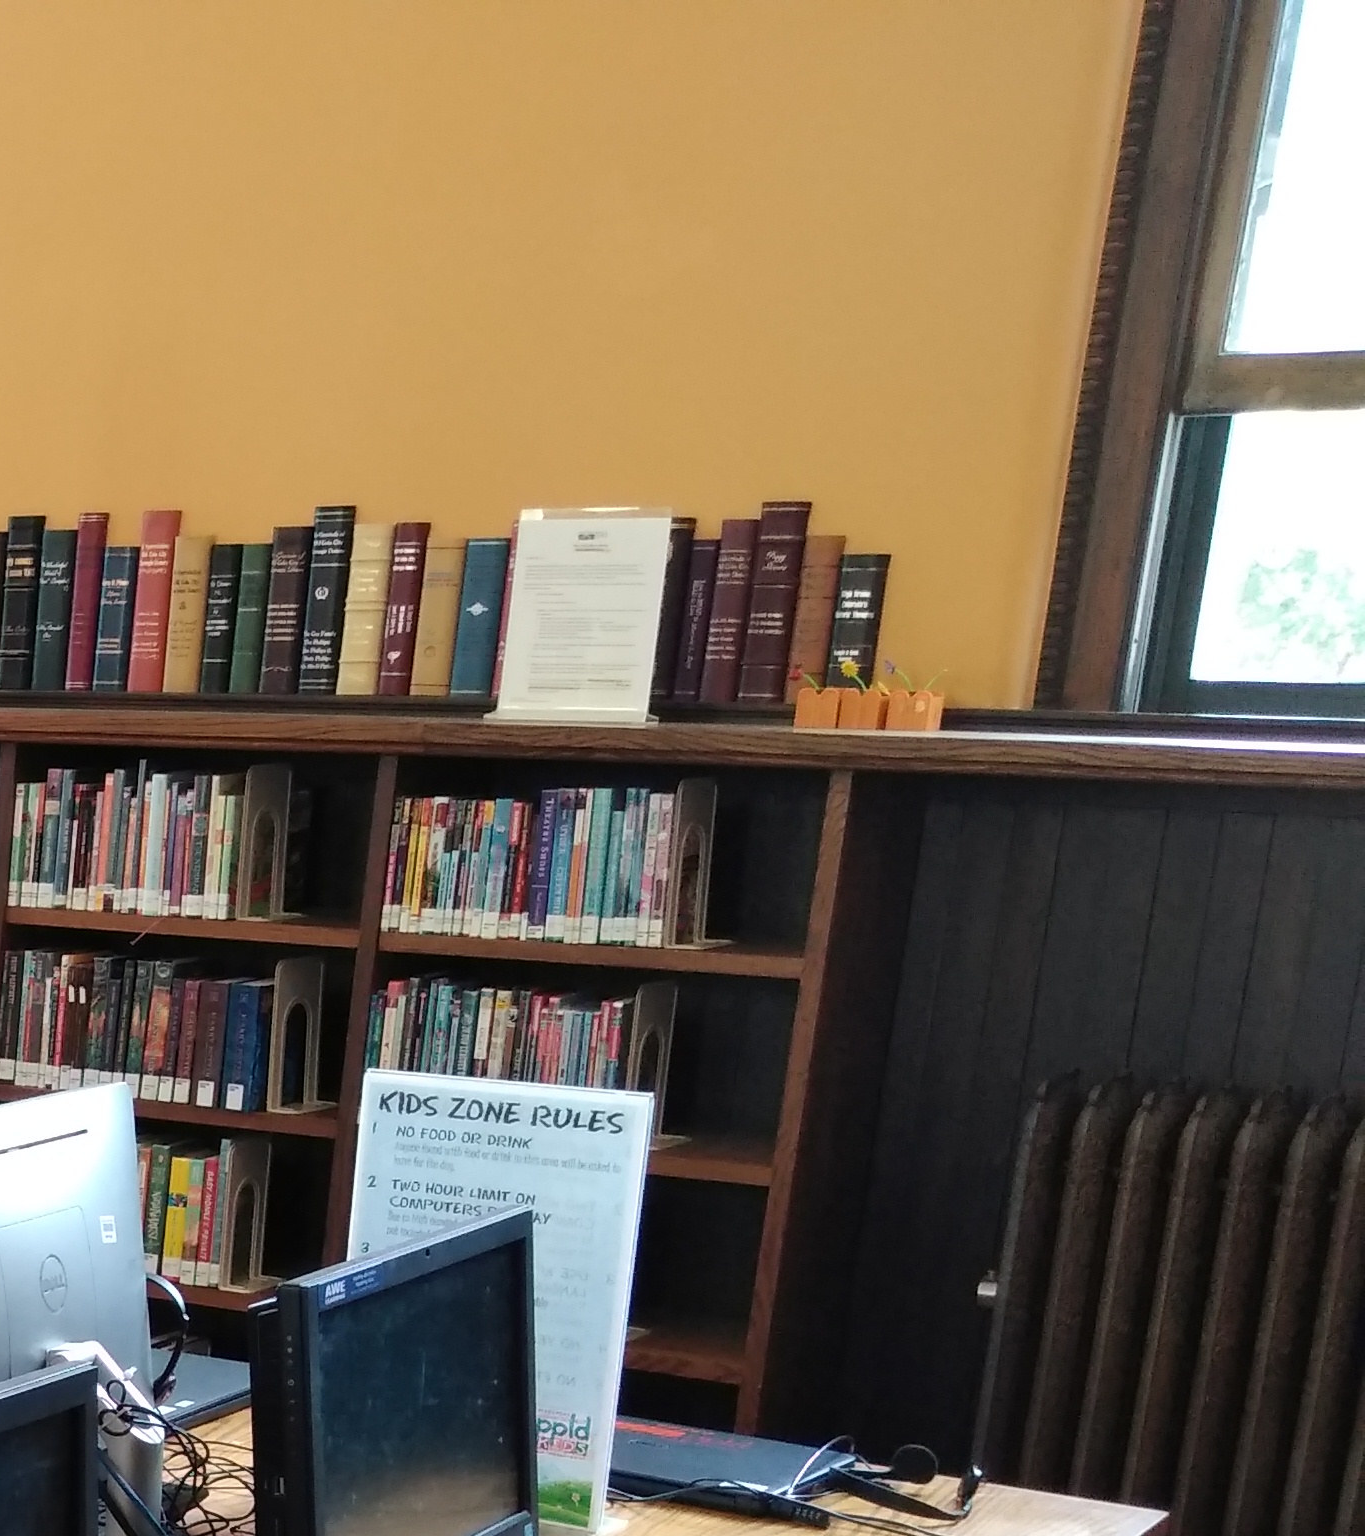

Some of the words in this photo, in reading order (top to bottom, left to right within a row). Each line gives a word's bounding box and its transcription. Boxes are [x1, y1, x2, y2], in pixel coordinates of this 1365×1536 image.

[378, 1090, 439, 1117] KIDS
[447, 1097, 521, 1125] ZONE
[530, 1104, 625, 1135] RULES
[395, 1126, 415, 1138] NO
[419, 1127, 457, 1142] FOOD
[461, 1131, 482, 1145] OR
[487, 1133, 533, 1150] DRINK
[367, 1175, 377, 1188] 2
[391, 1178, 420, 1193] TWO
[425, 1182, 464, 1198] HOUR
[469, 1187, 511, 1202] LIMIT
[515, 1192, 536, 1206] ON
[389, 1195, 482, 1217] COMPUTERS
[361, 1242, 370, 1254] 3
[325, 1279, 346, 1298] AWE
